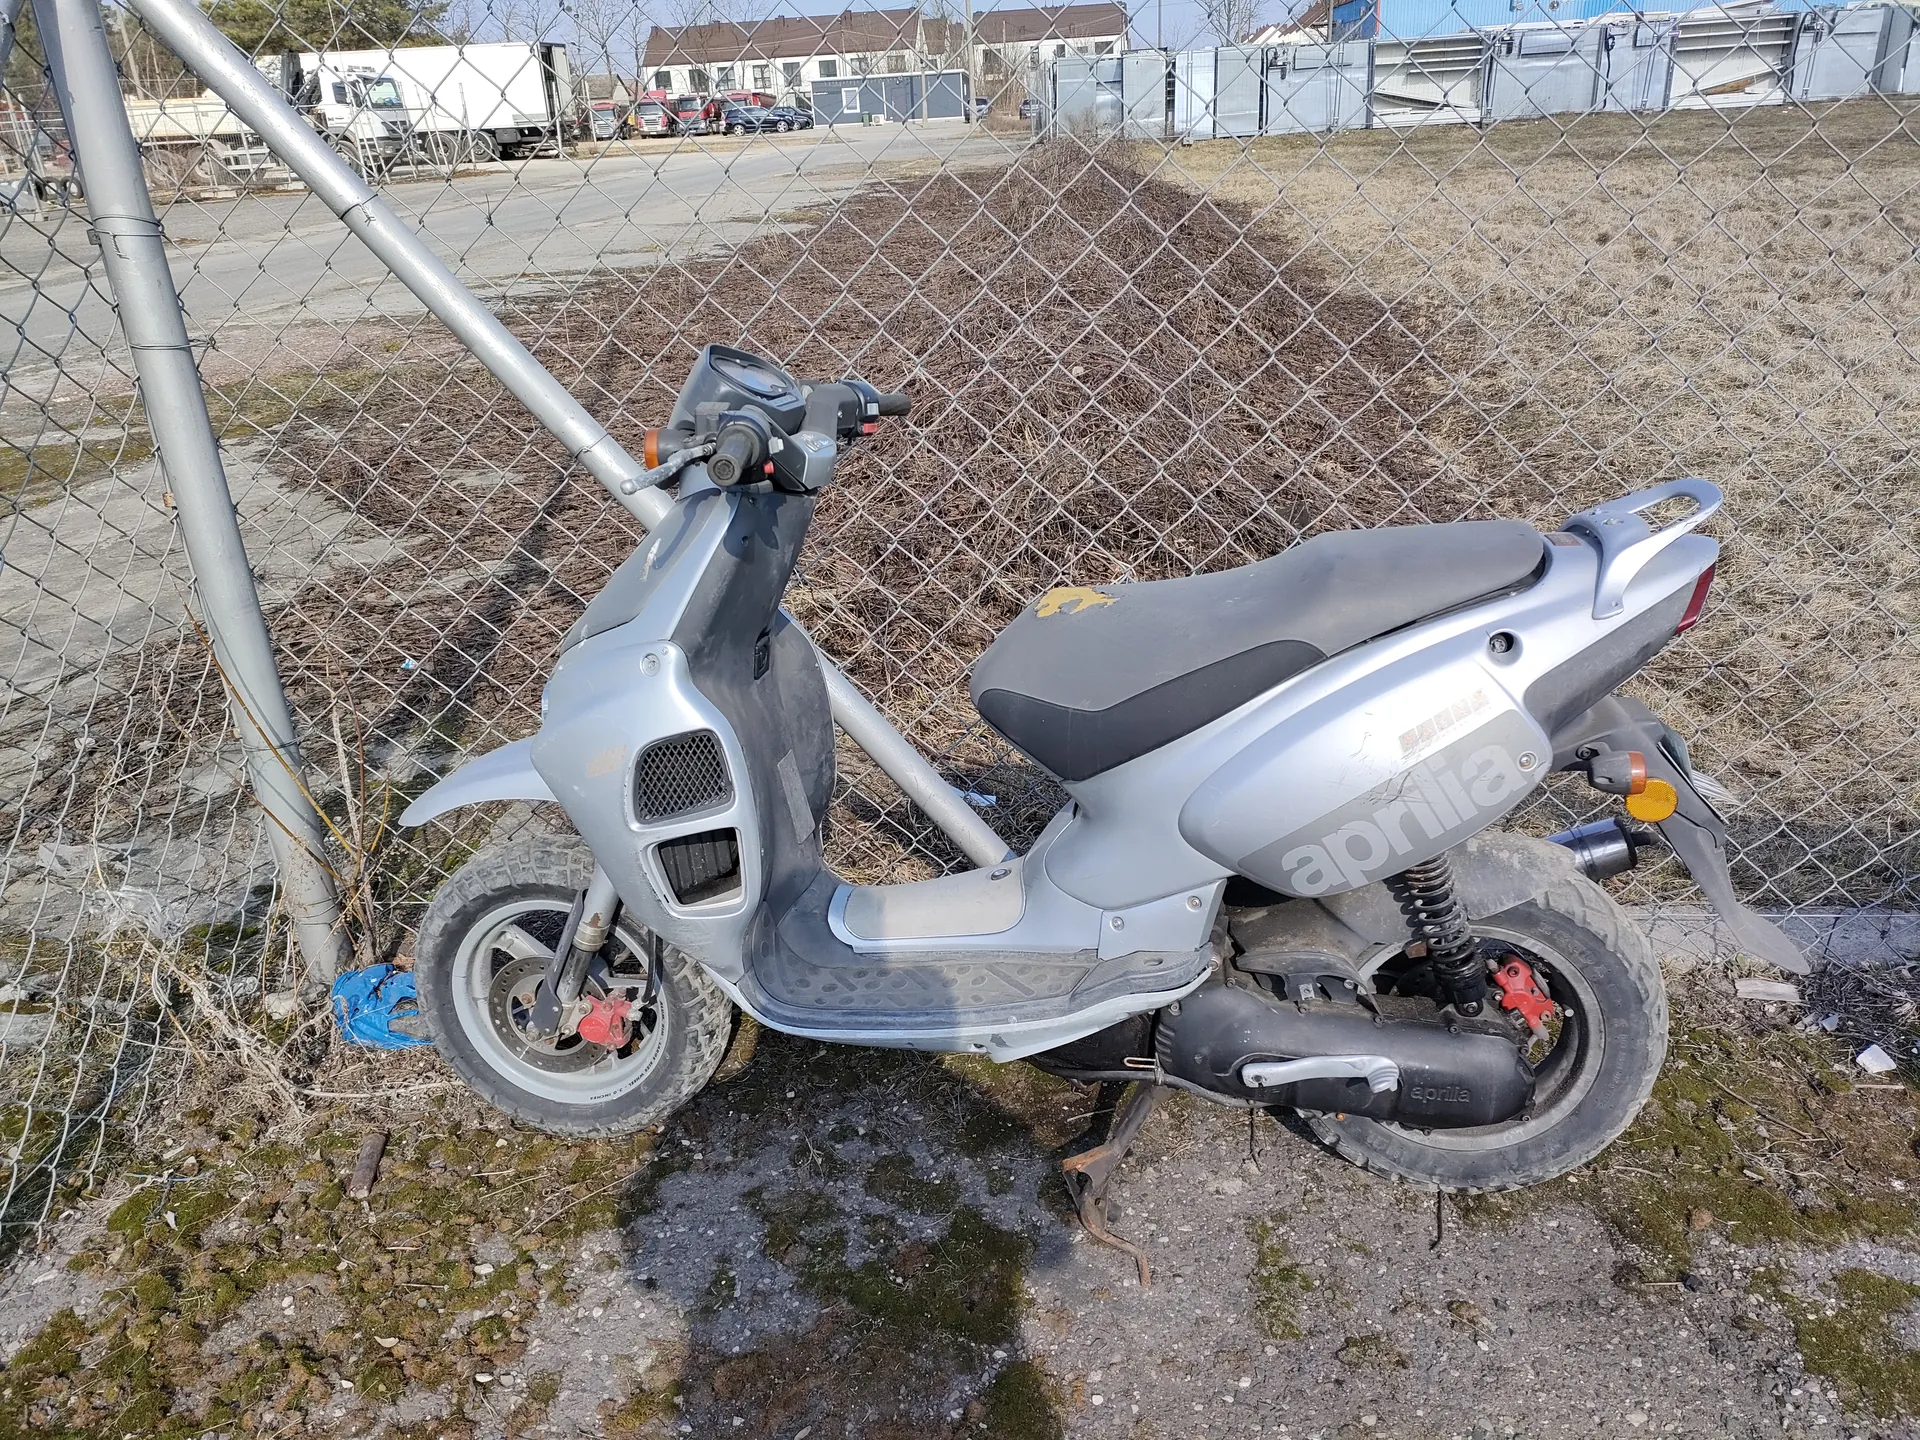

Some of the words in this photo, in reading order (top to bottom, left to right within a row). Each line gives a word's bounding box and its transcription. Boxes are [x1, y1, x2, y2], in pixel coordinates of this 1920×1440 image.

[1281, 744, 1528, 896] aprilia
[652, 1042, 662, 1062] LARGE
[644, 1060, 653, 1073] SIZE
[628, 1073, 645, 1087] WHEEL
[590, 1093, 612, 1101] INCHES
[1410, 1085, 1471, 1104] aprilia
